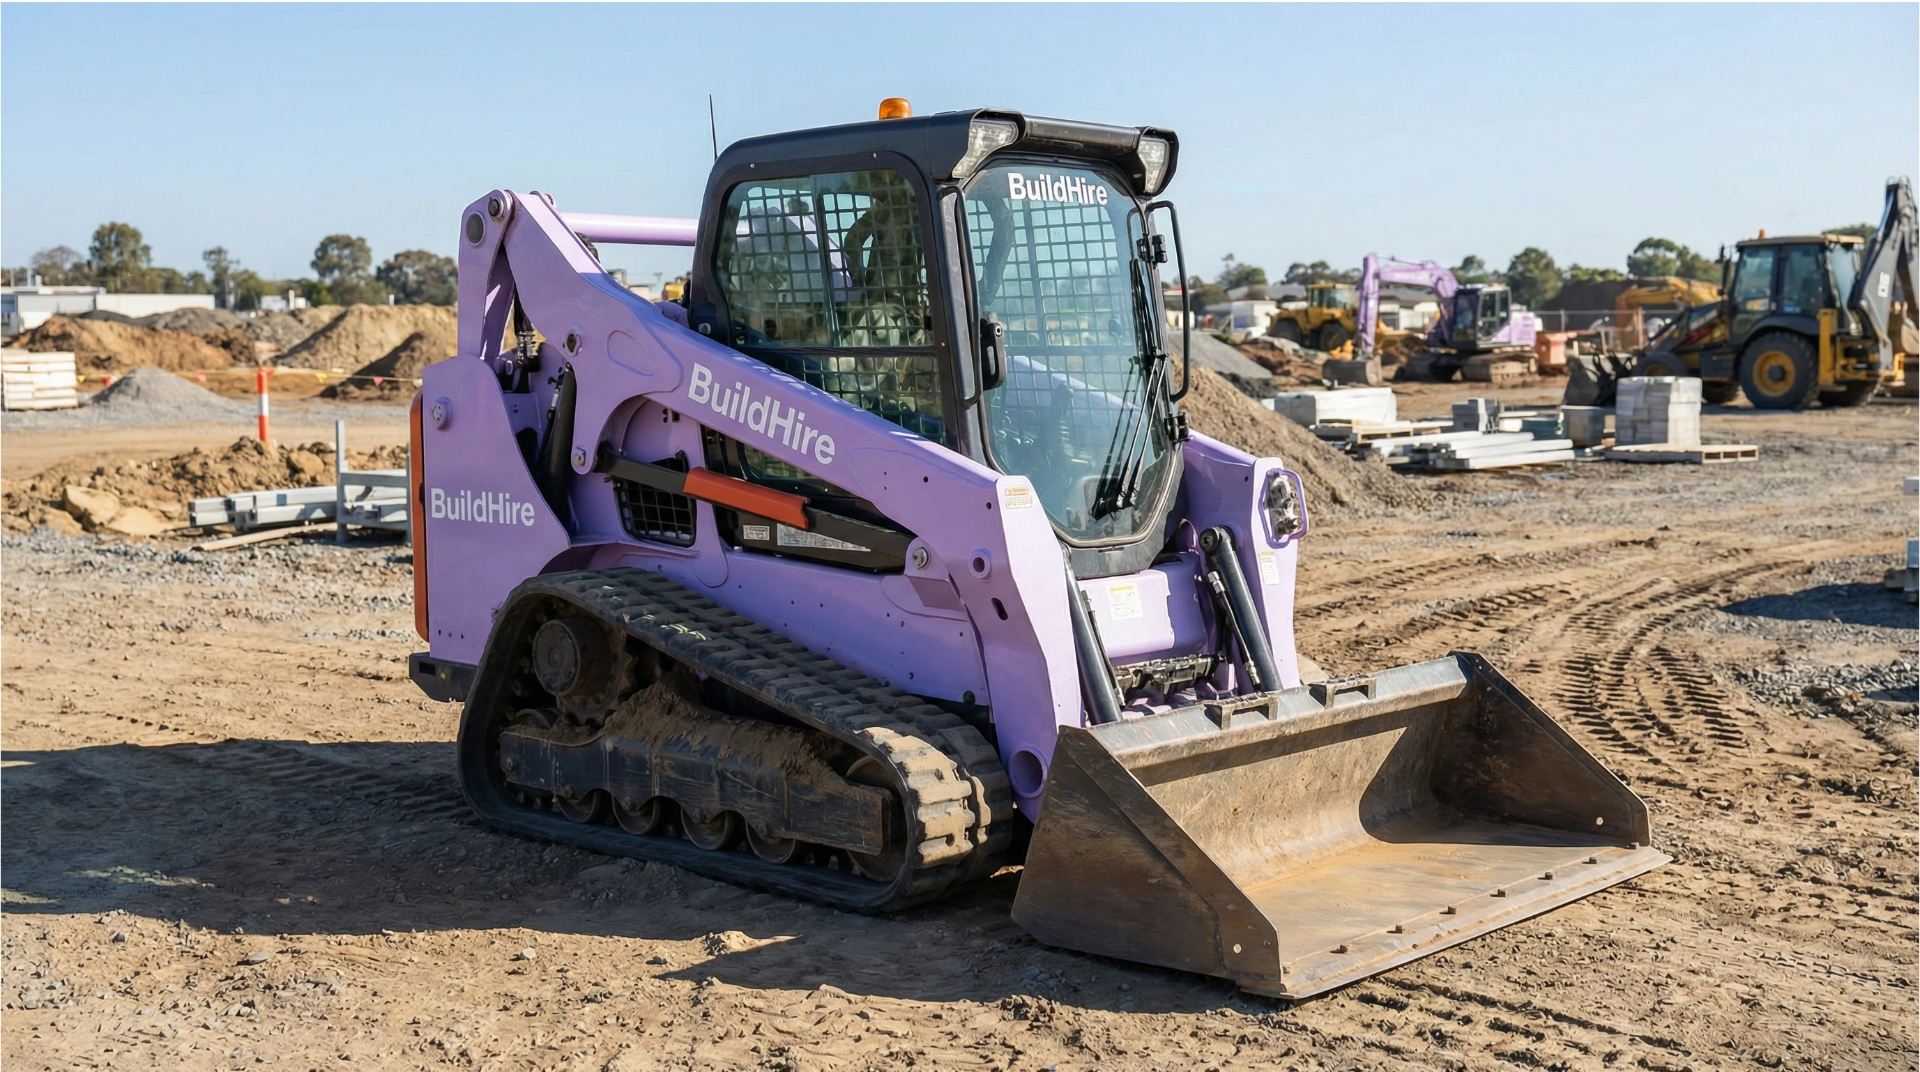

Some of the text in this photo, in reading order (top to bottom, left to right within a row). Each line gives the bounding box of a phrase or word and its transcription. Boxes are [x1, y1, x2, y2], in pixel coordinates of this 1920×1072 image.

[1008, 172, 1108, 205] BuildHire
[688, 362, 835, 465] BuildHire
[431, 488, 535, 527] BuildHire
